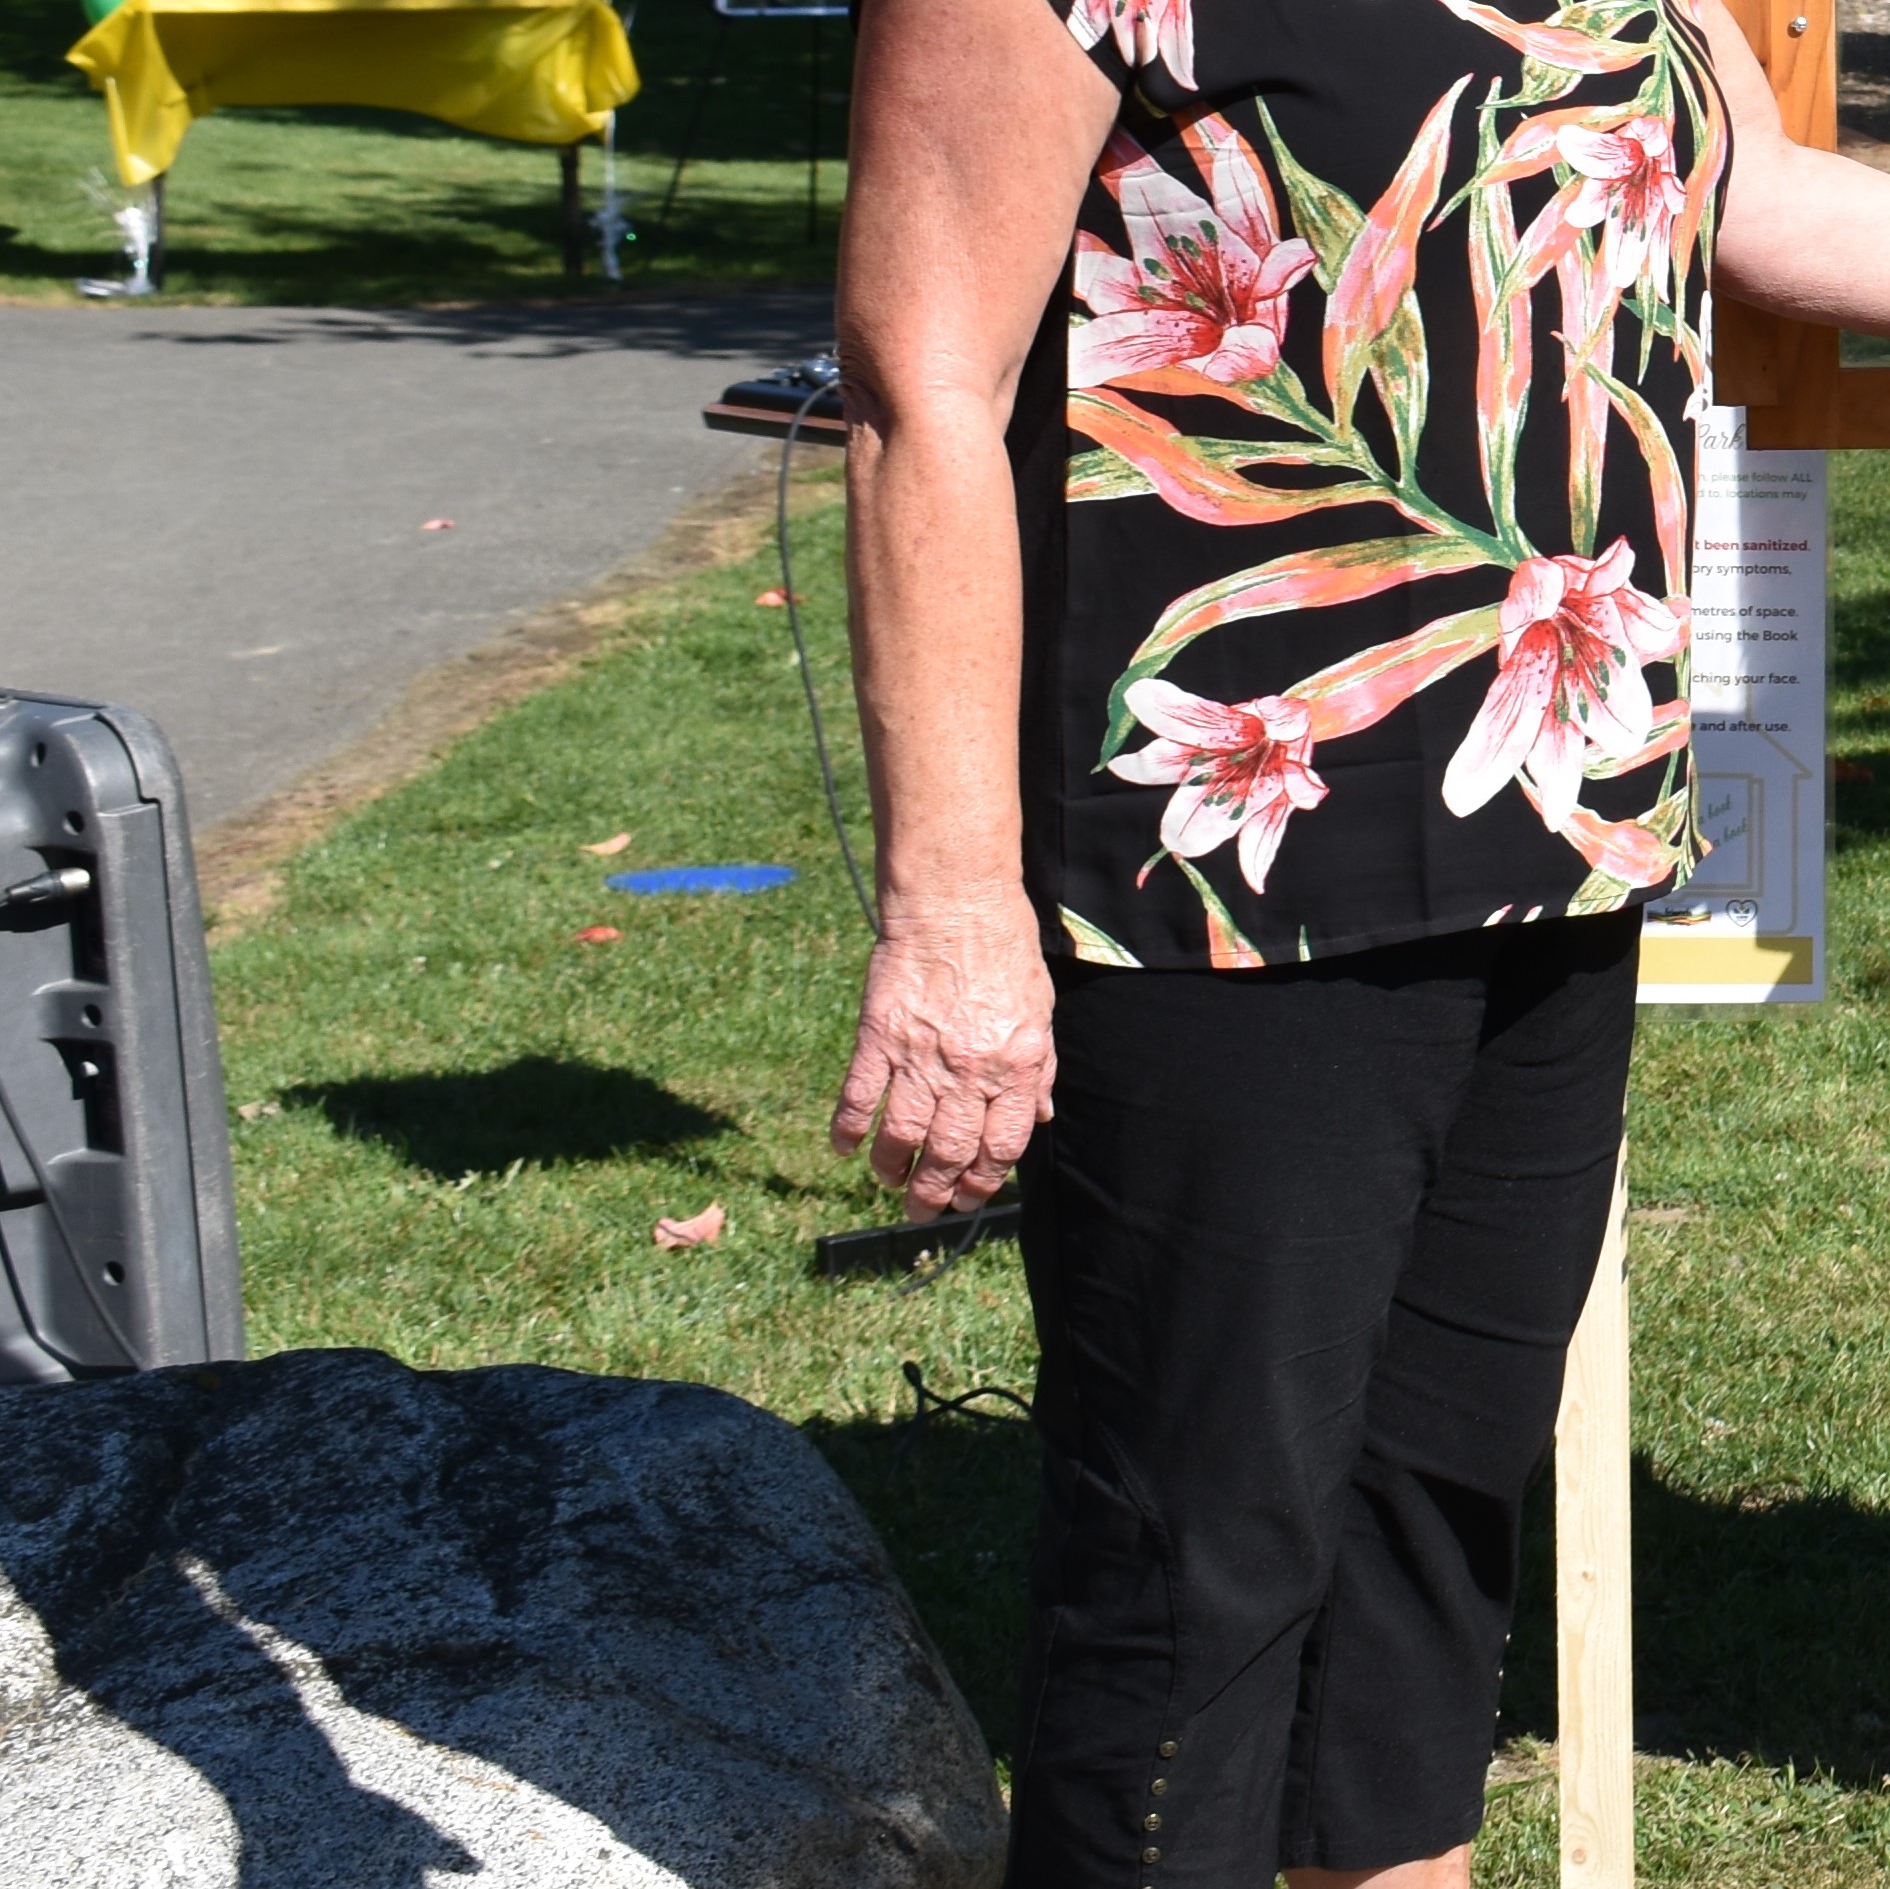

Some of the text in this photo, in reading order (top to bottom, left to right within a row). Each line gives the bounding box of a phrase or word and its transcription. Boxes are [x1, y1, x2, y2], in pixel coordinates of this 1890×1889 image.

[1698, 423, 1747, 450] Park
[1712, 472, 1813, 483] please follow ALL
[1726, 488, 1808, 500] locations may
[1704, 540, 1812, 551] been sanitized.
[1717, 564, 1792, 576] symptoms,
[1691, 606, 1798, 619] metres of space.
[1695, 630, 1798, 643] using the Book
[1735, 674, 1765, 686] your
[1768, 673, 1800, 684] face.
[1700, 721, 1791, 732] and after use.
